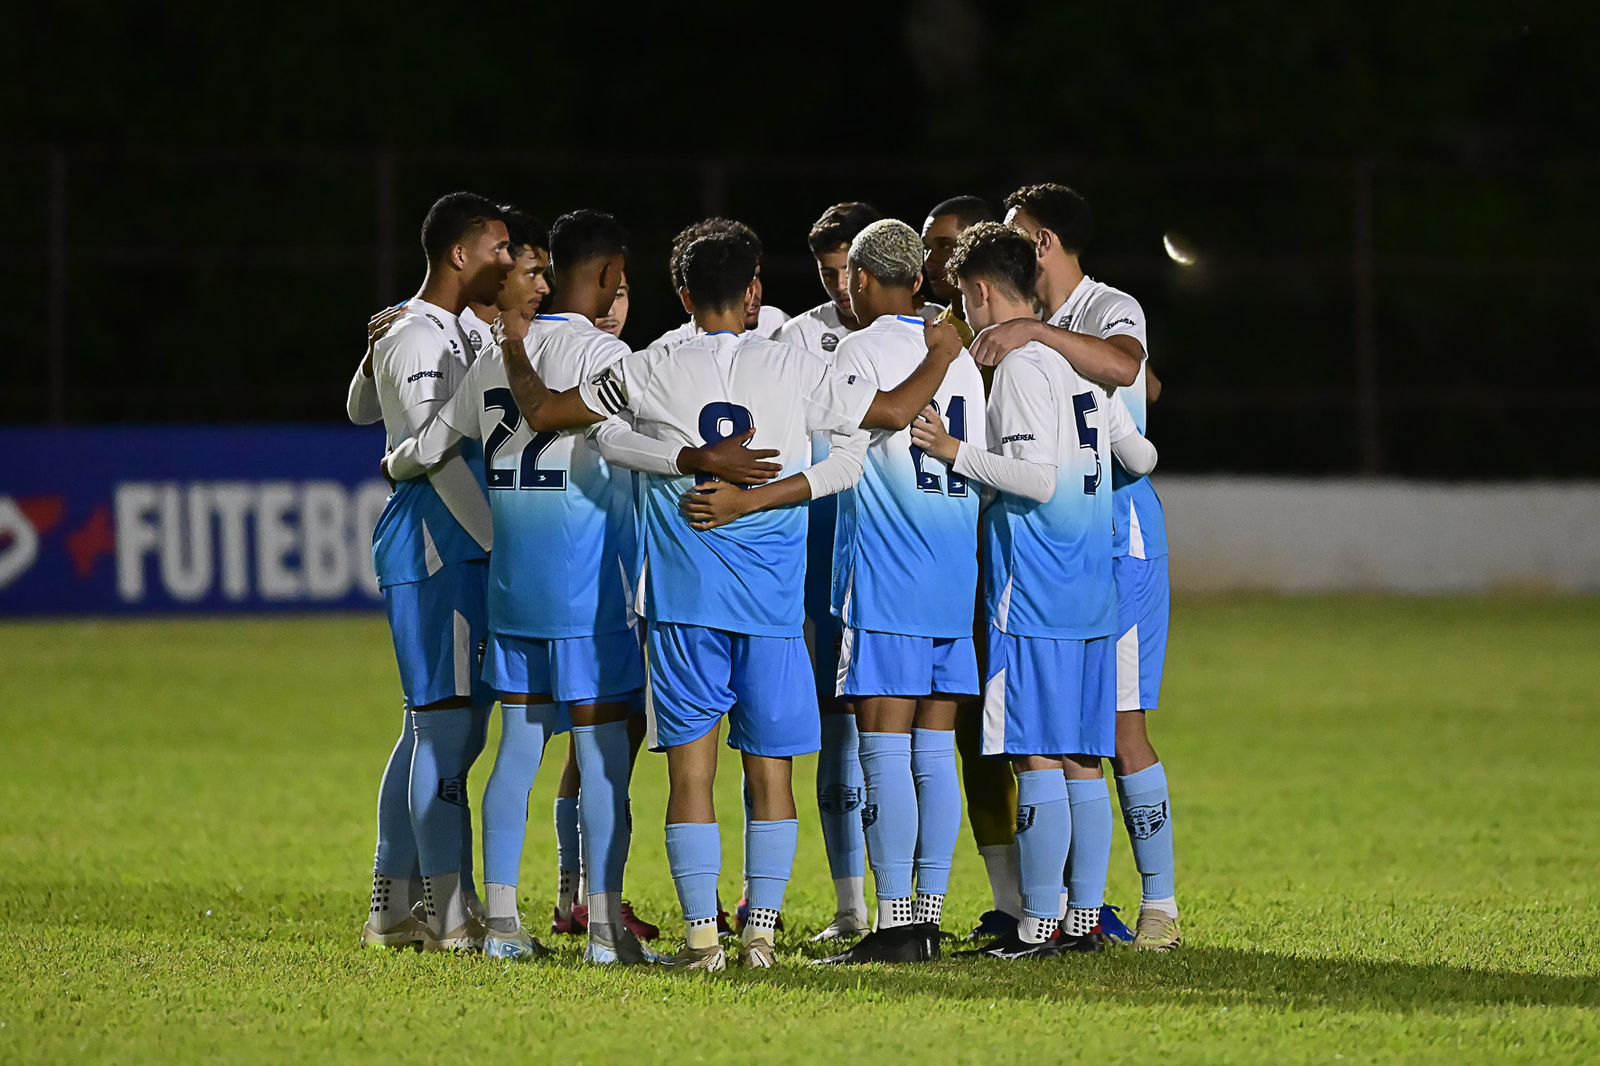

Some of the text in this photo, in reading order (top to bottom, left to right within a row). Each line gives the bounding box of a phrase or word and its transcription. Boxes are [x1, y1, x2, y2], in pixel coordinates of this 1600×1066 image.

[483, 386, 567, 491] 22
[694, 401, 757, 495] 8
[1071, 390, 1102, 496] 5
